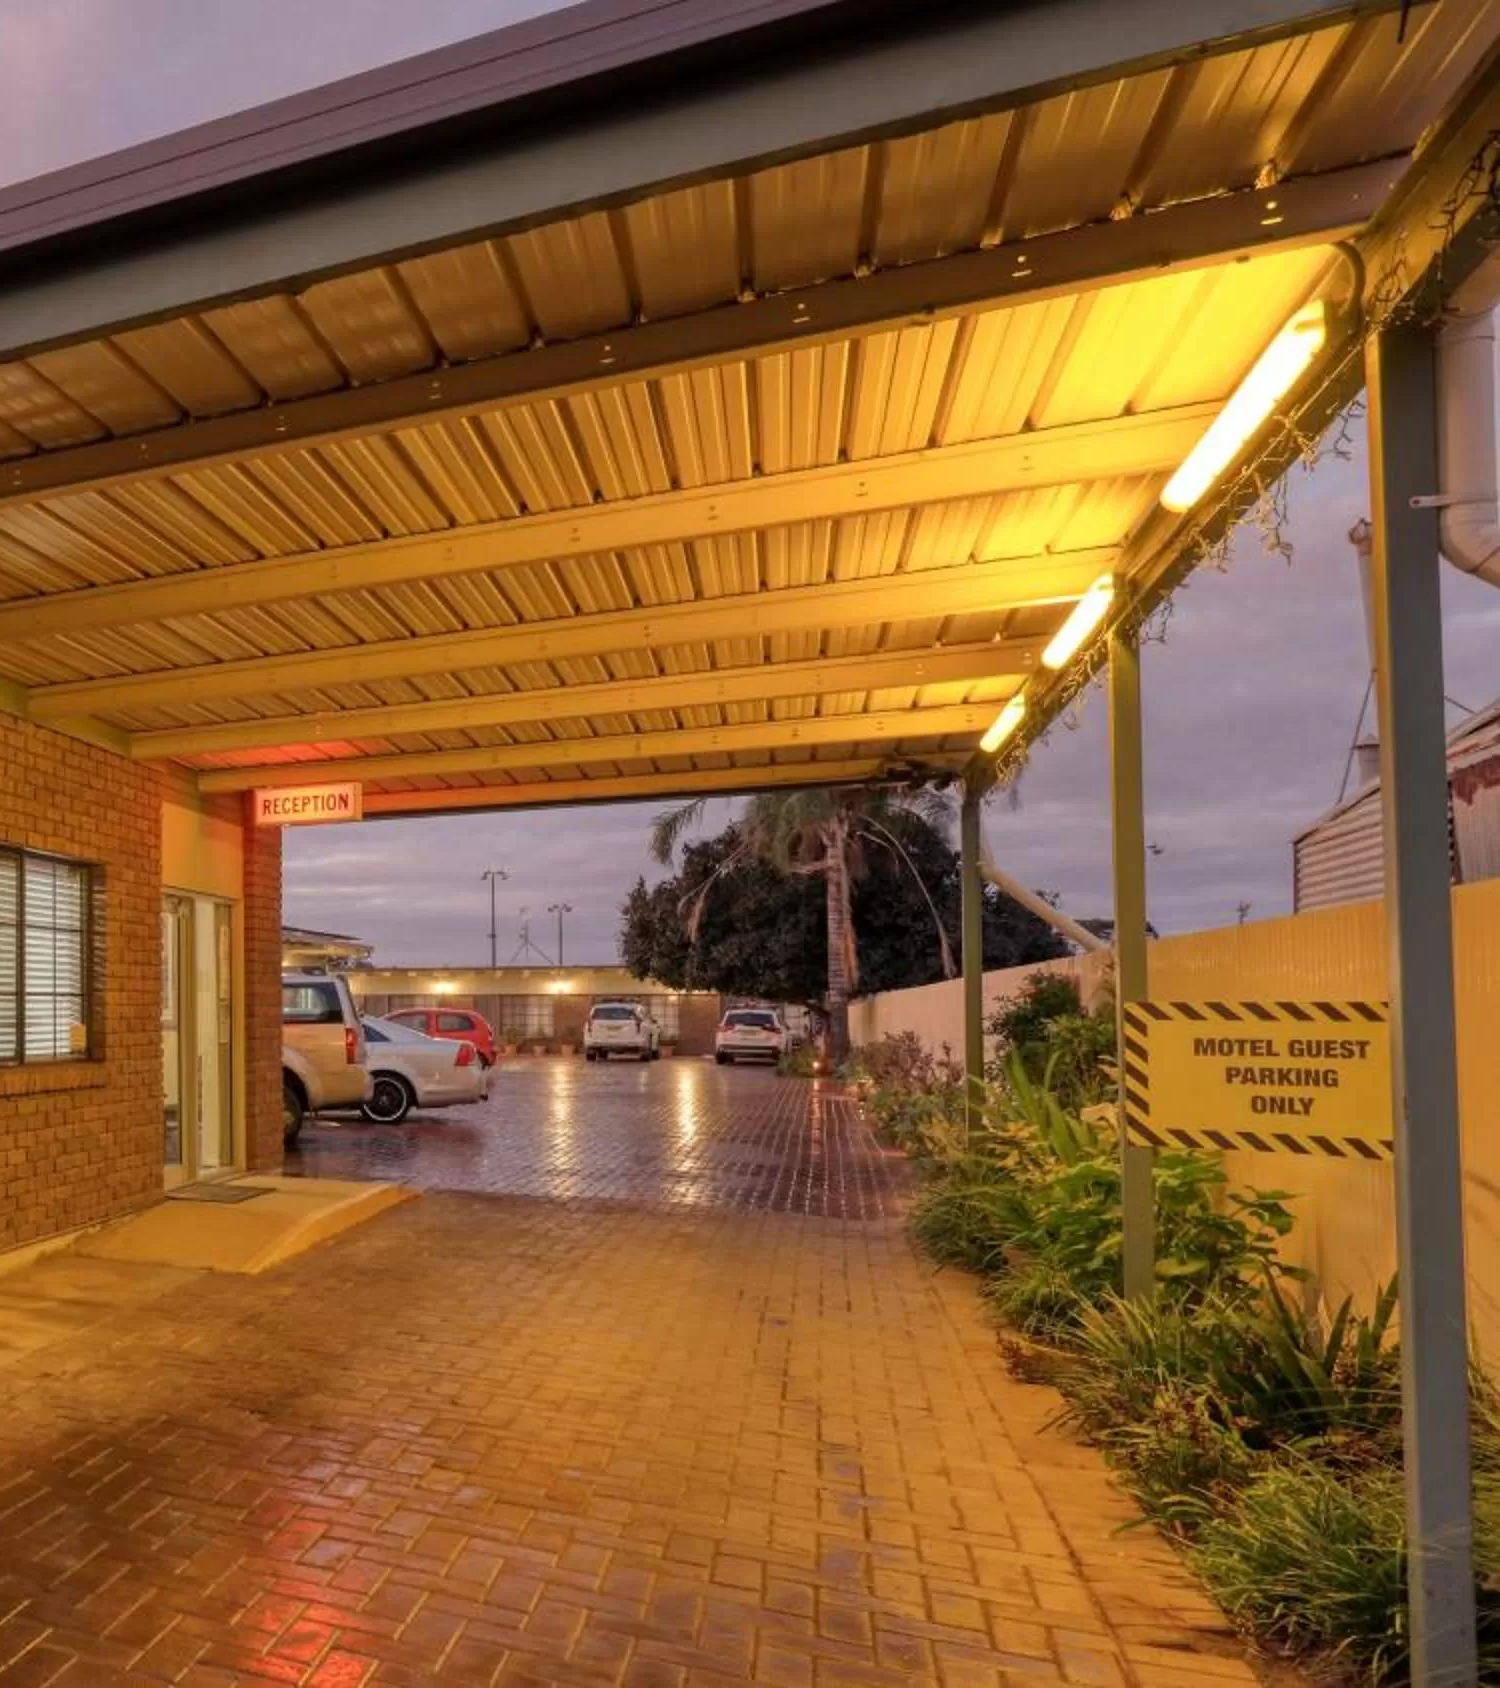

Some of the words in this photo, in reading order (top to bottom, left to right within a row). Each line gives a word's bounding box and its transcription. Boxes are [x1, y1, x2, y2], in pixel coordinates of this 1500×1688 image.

[262, 793, 349, 816] RECEPTION
[1193, 1038, 1280, 1057] MOTEL
[1288, 1040, 1370, 1059] GUEST
[1225, 1067, 1339, 1088] PARKING
[1251, 1095, 1315, 1116] ONLY
